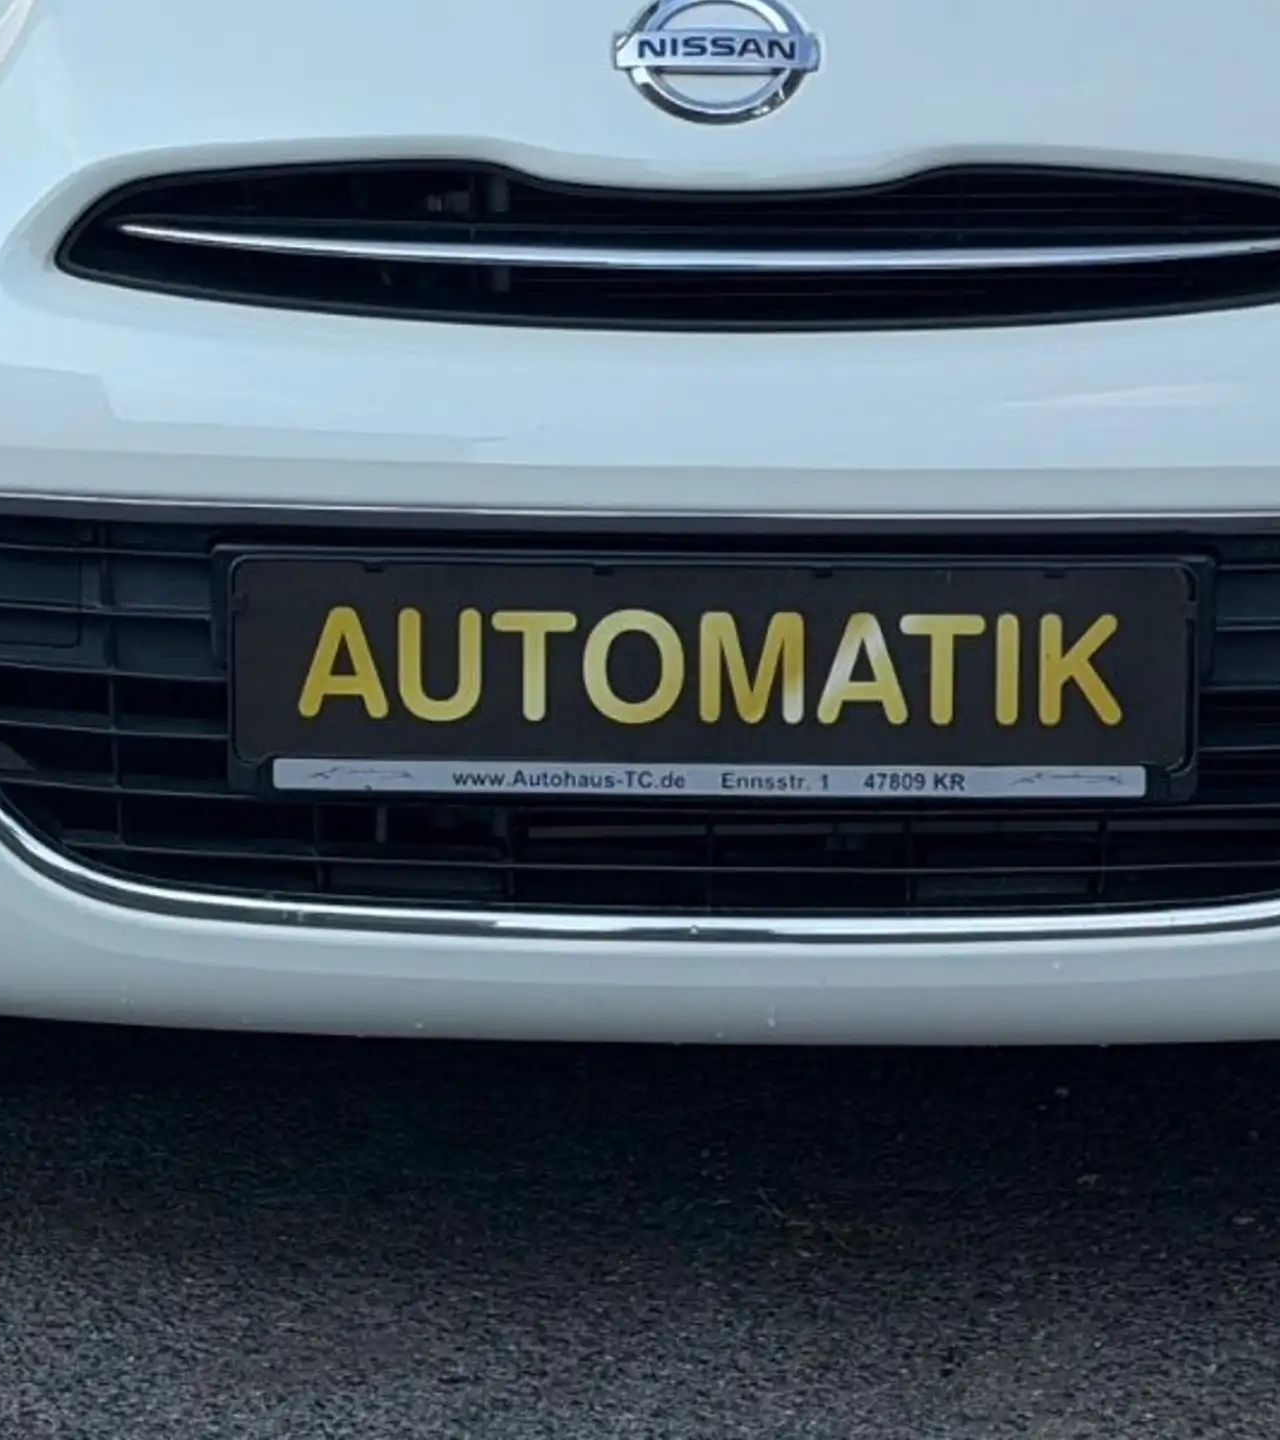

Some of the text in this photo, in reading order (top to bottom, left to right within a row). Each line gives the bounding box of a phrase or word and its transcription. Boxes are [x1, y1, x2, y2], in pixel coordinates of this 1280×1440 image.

[637, 36, 796, 60] NISSAN
[297, 607, 1122, 726] AUTOMATIK
[452, 770, 966, 790] www.Autohaus-TC.de Ennsstr. 1 47809 KR
